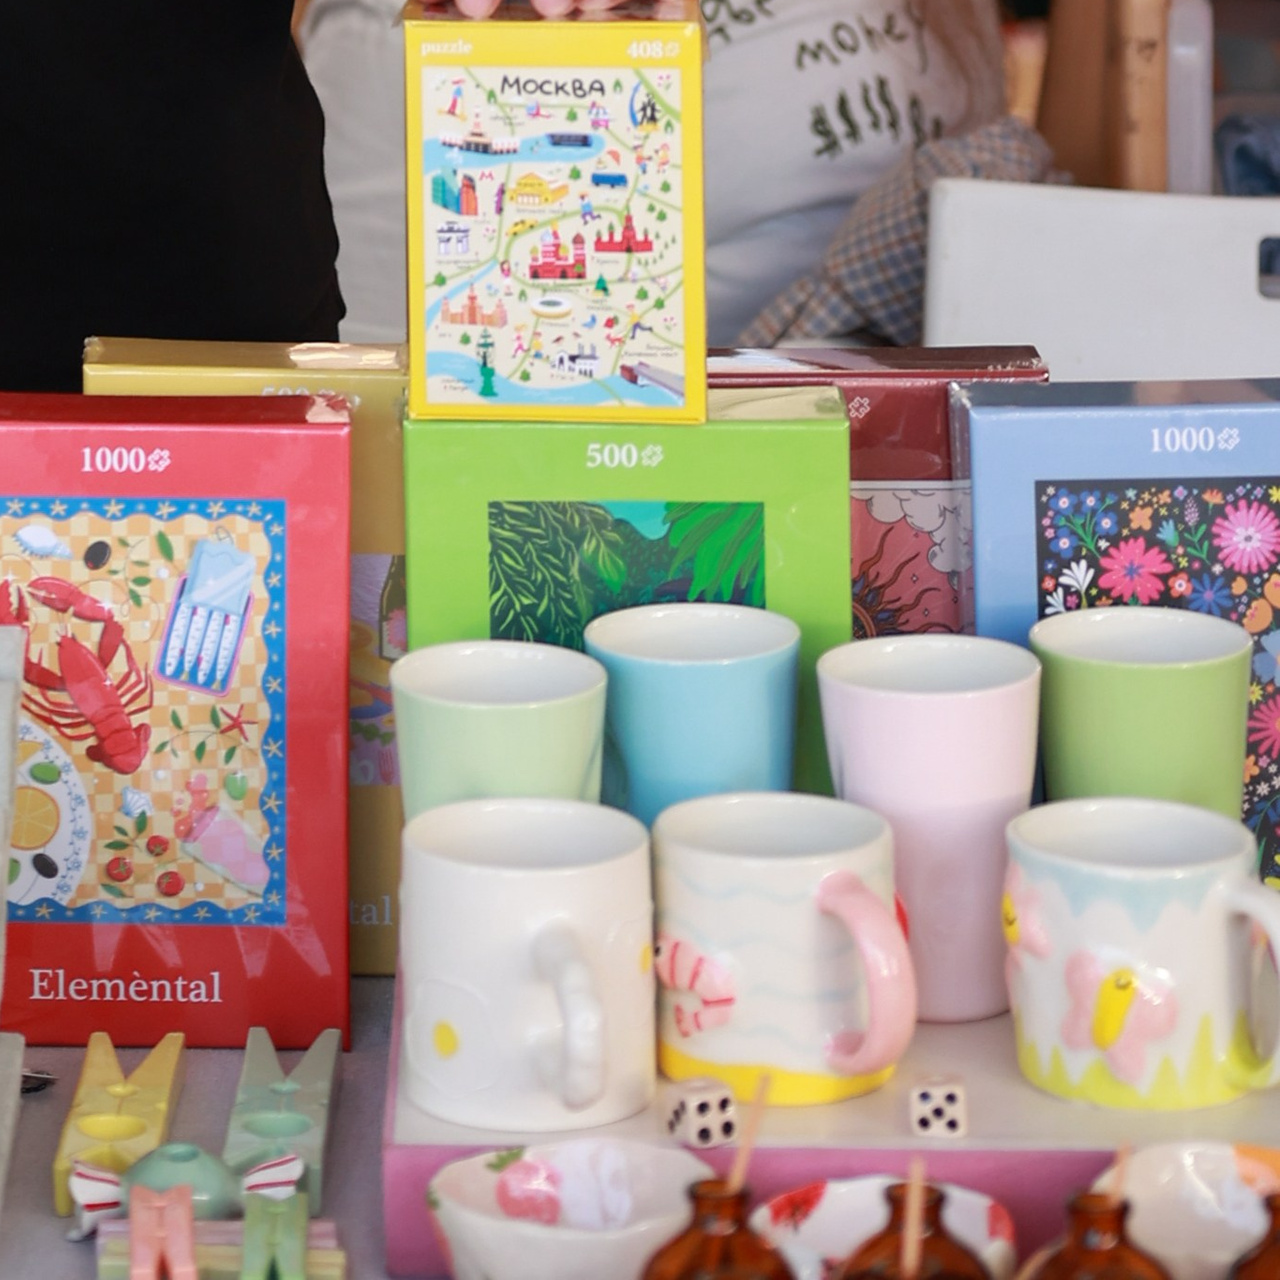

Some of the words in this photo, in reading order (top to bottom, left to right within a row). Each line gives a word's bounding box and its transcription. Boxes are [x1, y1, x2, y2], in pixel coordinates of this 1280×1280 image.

[420, 40, 472, 57] puzzle
[626, 39, 663, 59] 408
[1151, 426, 1216, 453] 1000
[81, 446, 146, 473] 1000
[586, 442, 639, 468] 500
[29, 968, 223, 1003] Elemèntal
